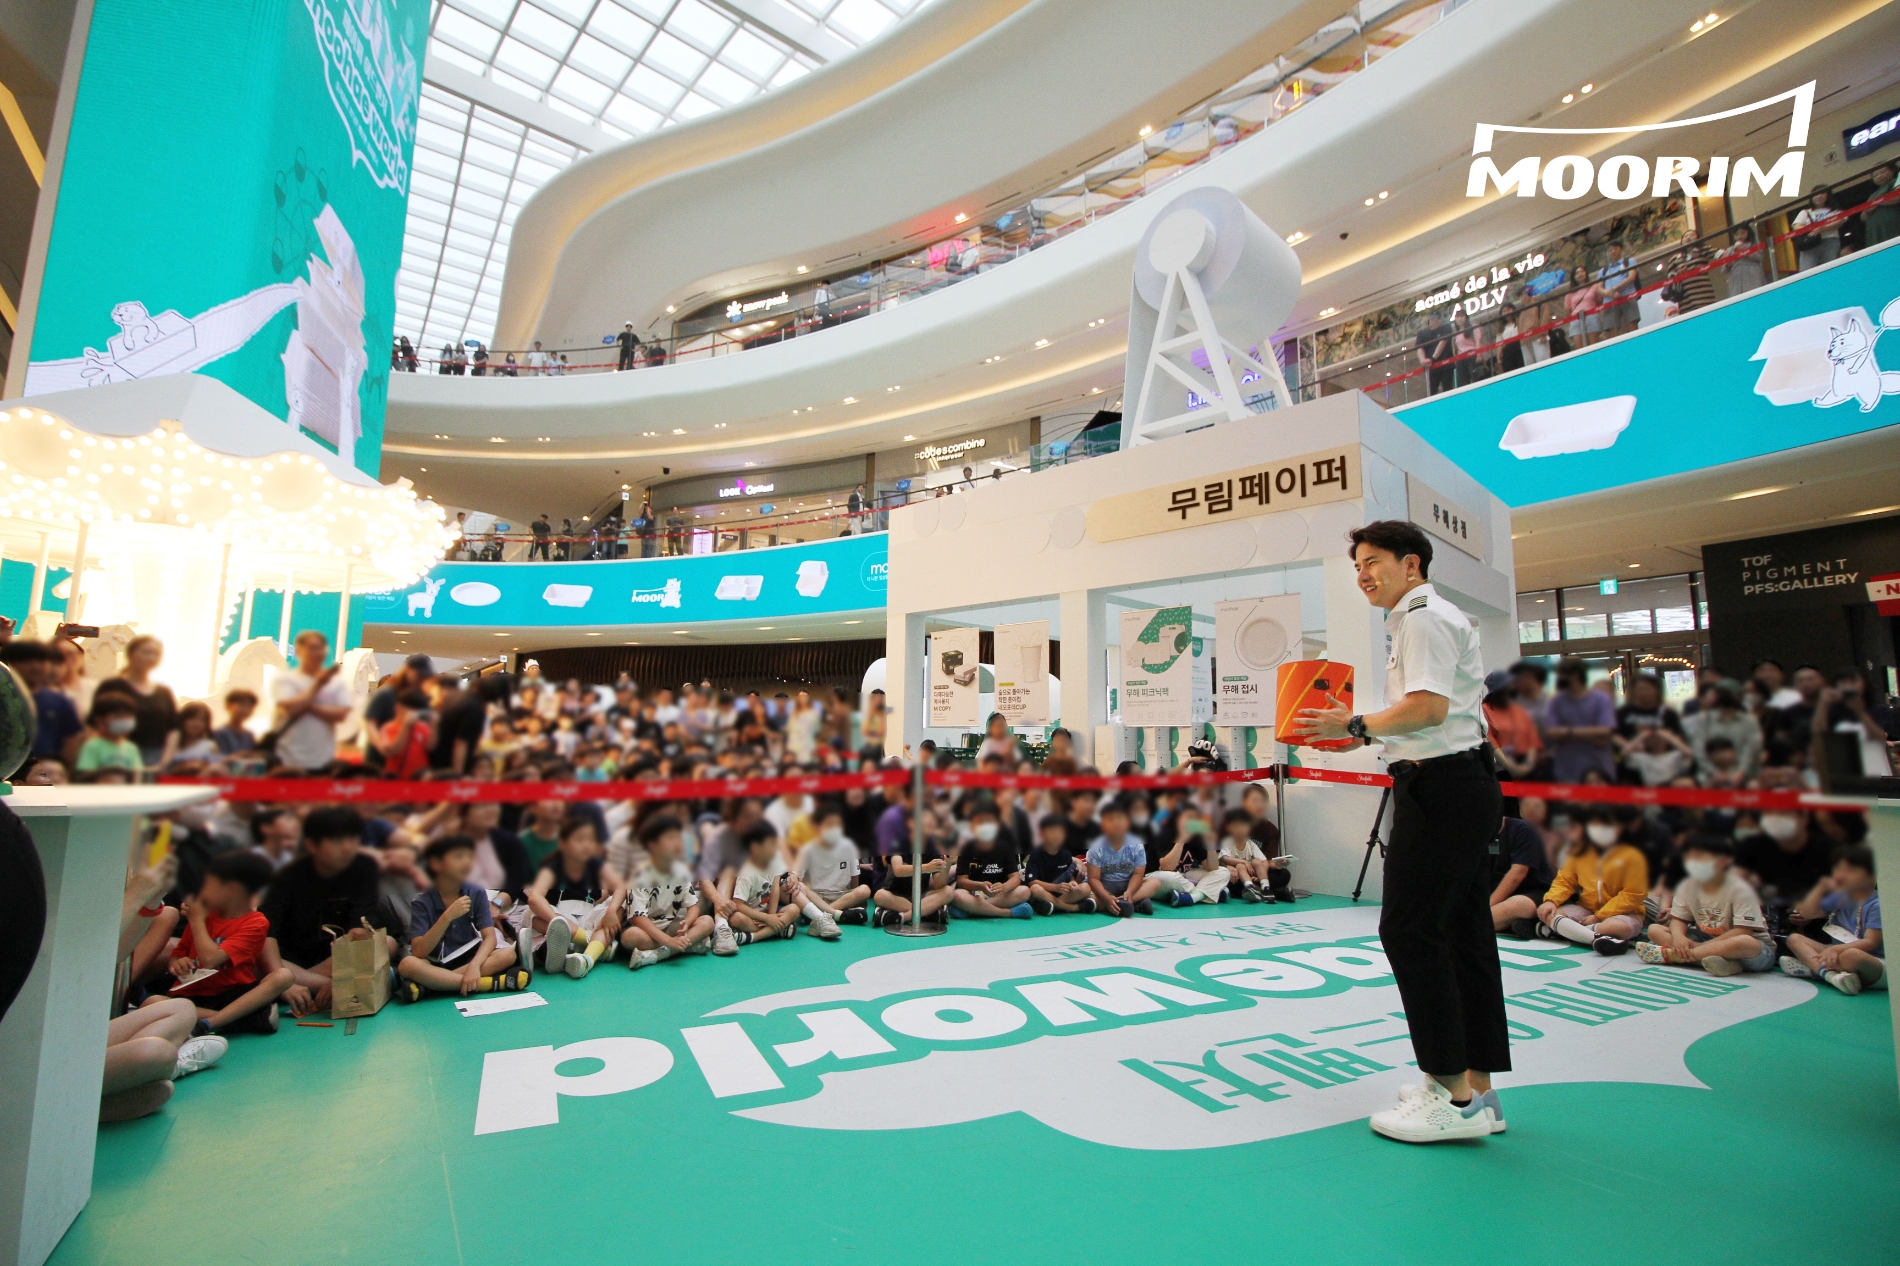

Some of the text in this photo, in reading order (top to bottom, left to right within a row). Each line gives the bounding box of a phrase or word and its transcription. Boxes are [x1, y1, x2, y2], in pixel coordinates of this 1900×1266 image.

[1415, 252, 1545, 312] acmé de la vie
[719, 488, 741, 497] LOOK
[1167, 455, 1347, 520] 무림페이퍼
[1741, 555, 1772, 567] TOF
[1742, 559, 1847, 582] PIGMENT
[1744, 572, 1859, 595] PFS:GALLERY
[1126, 687, 1169, 698] 무해 피크닉팩
[1222, 684, 1258, 694] 무해 접시
[1233, 921, 1325, 937] 무림
[1017, 933, 1197, 962] 스타필드
